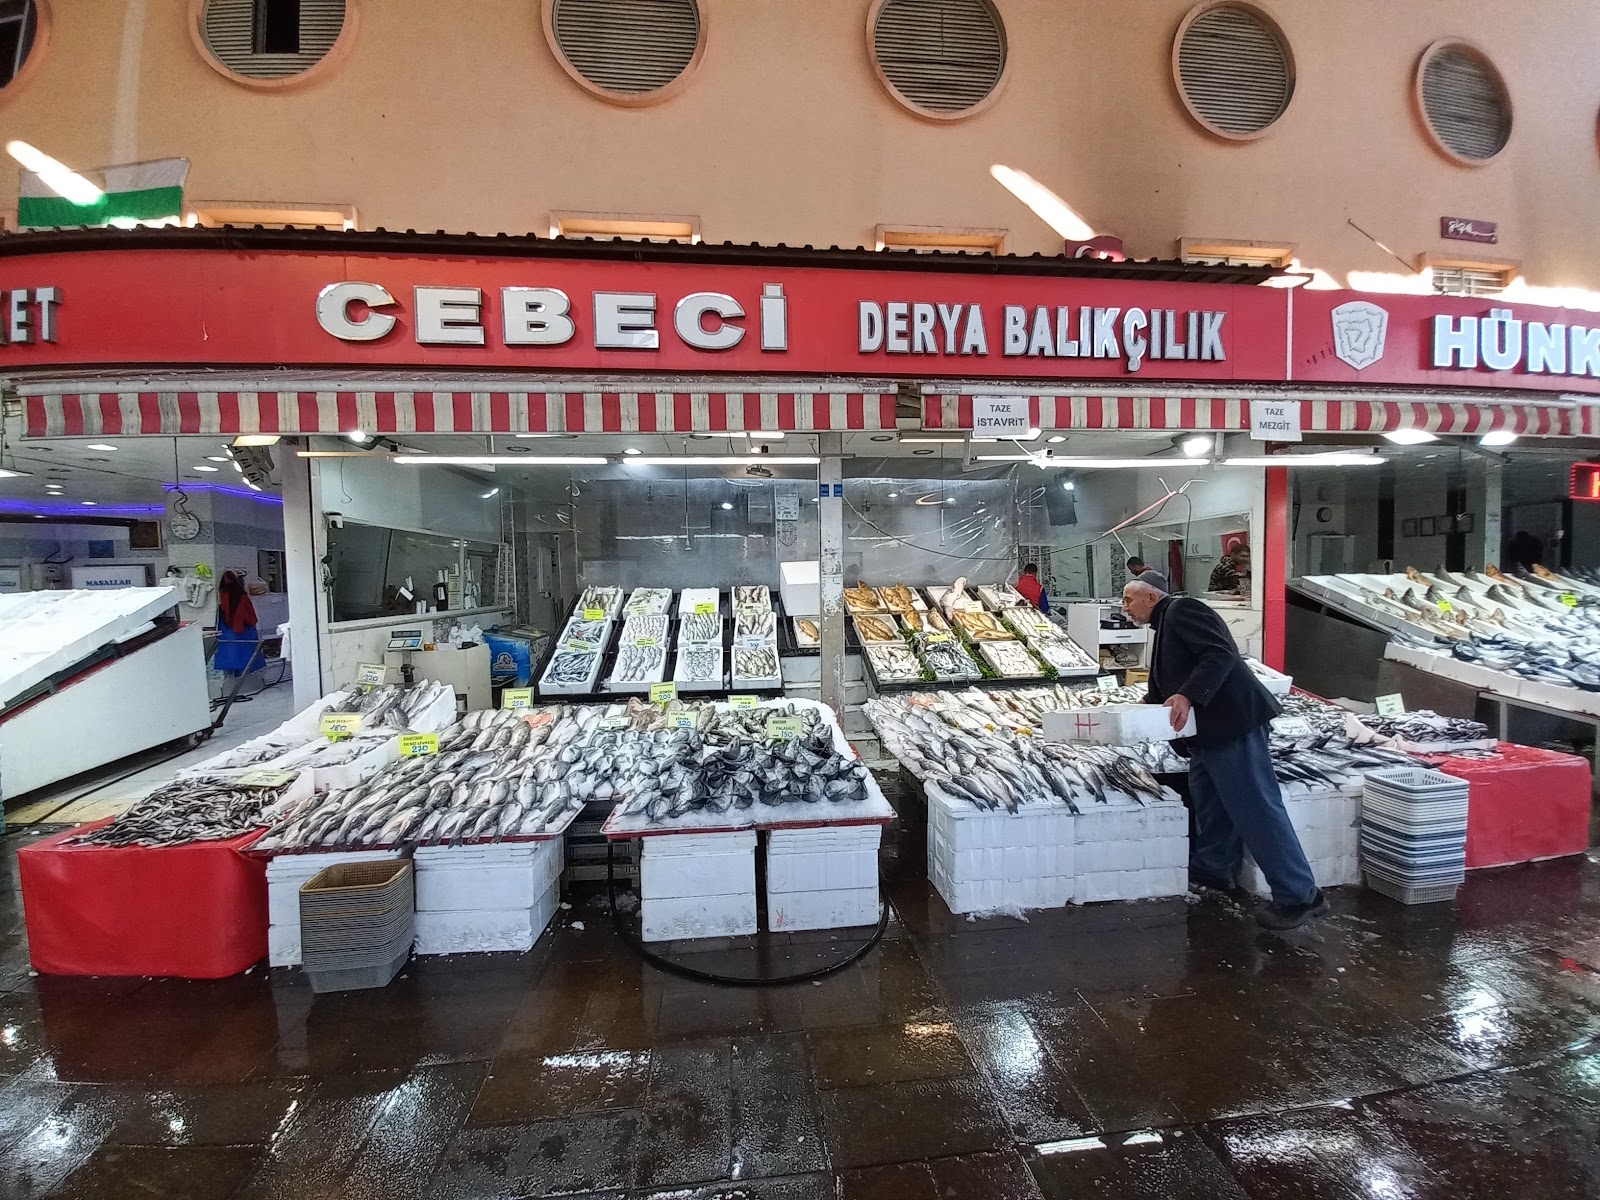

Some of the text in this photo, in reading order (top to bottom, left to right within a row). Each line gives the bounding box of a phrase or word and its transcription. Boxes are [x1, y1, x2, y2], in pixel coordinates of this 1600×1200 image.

[0, 286, 62, 346] ET
[315, 281, 788, 351] CEBECİ
[857, 299, 1227, 372] DERYA BALIKÇILIK
[1433, 308, 1600, 378] HÜNK
[989, 404, 1012, 413] TAZE
[1264, 408, 1285, 417] TAZE
[977, 416, 1025, 428] İSTAVRİT
[1259, 420, 1291, 431] MEZGİT
[329, 724, 347, 732] 180
[781, 730, 794, 738] 150
